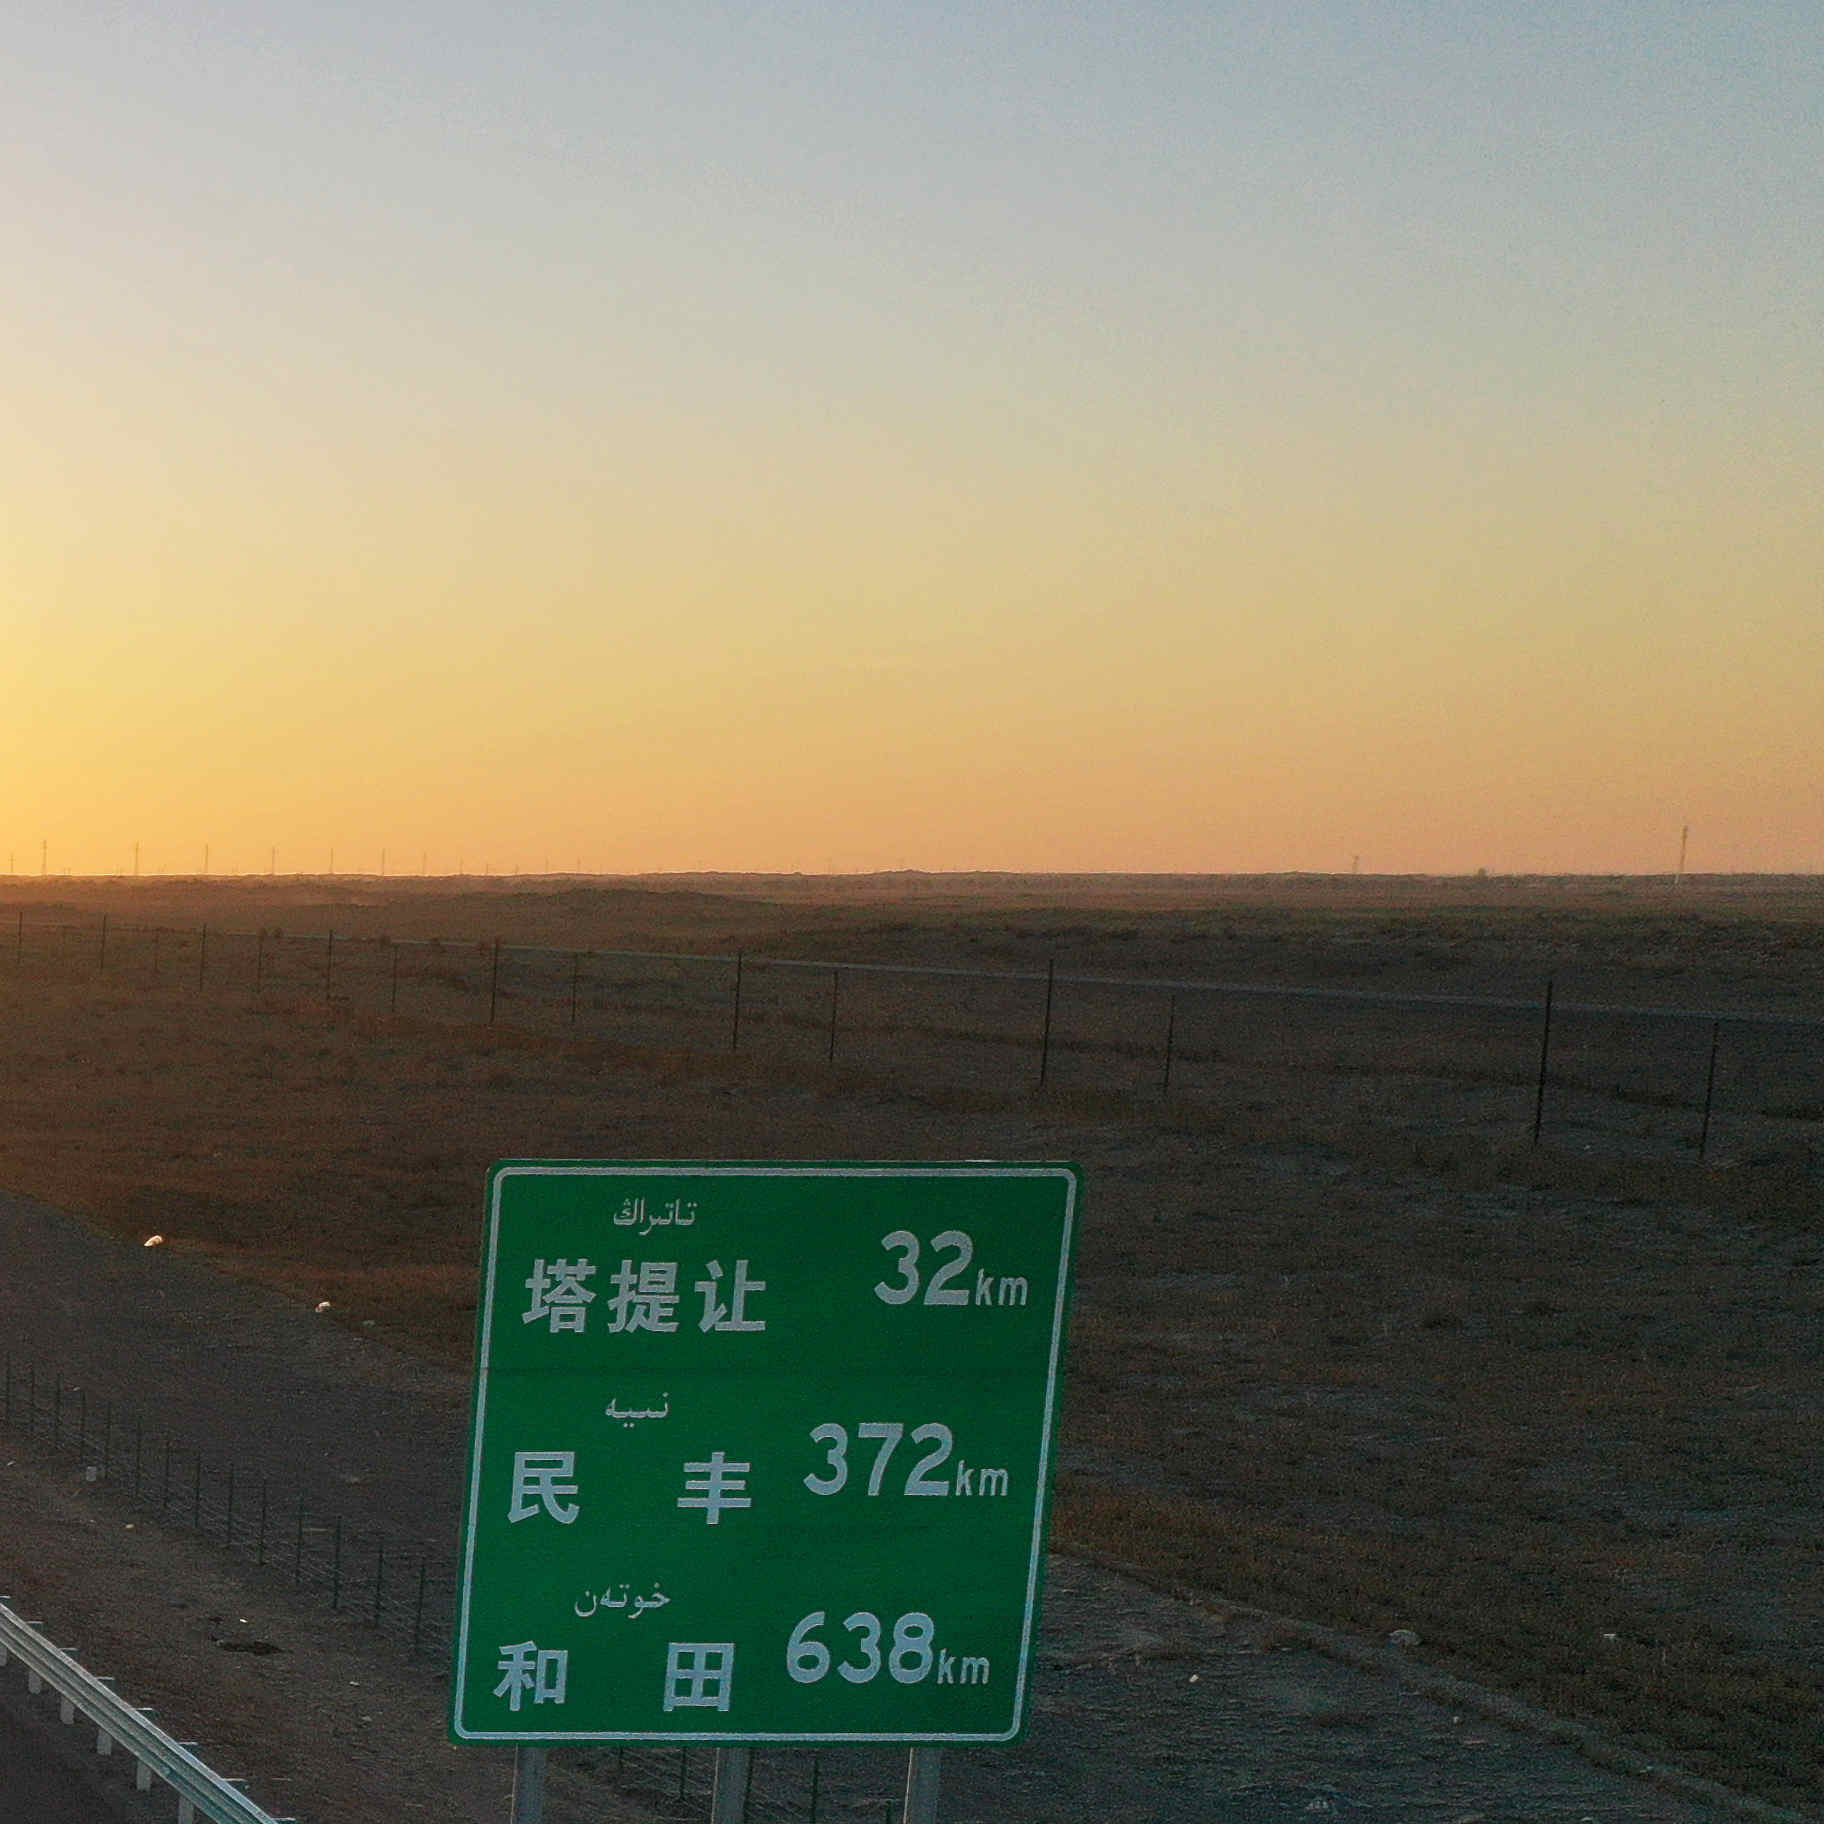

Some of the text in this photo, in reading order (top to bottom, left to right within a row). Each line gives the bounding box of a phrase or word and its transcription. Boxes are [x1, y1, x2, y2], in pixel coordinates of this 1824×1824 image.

[521, 1229, 1028, 1334] 塔提让 32km
[802, 1421, 1009, 1497] 372km
[786, 1611, 990, 1685] 638km
